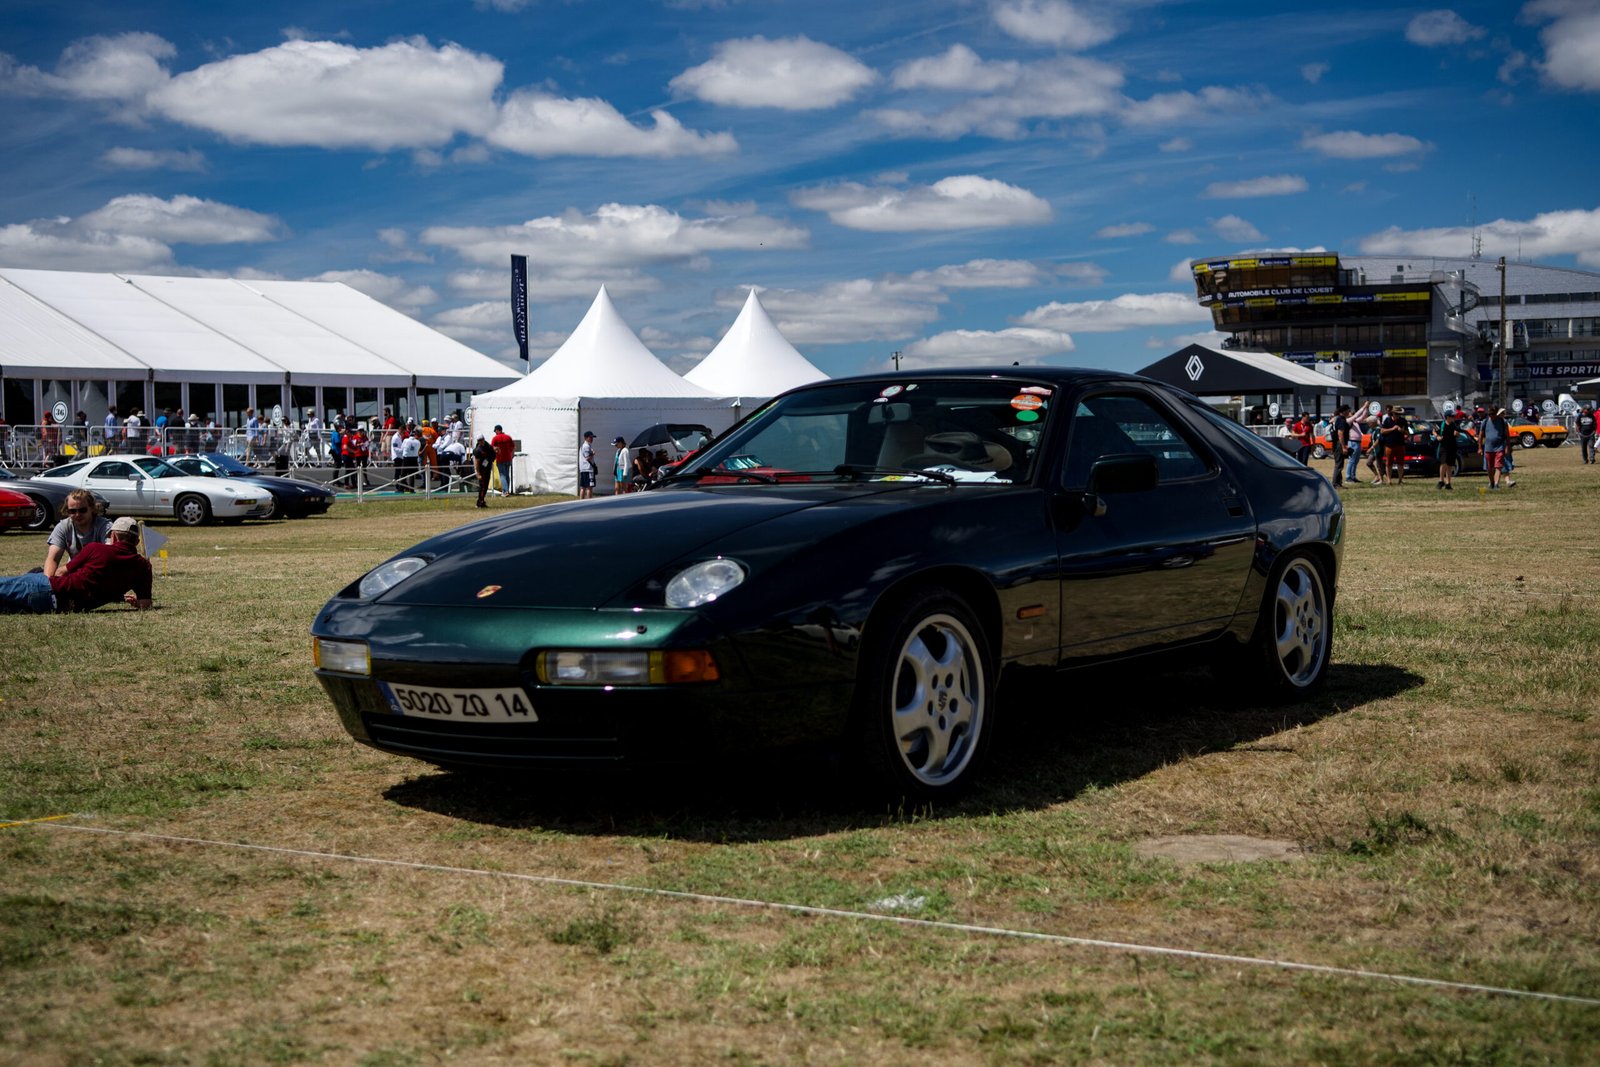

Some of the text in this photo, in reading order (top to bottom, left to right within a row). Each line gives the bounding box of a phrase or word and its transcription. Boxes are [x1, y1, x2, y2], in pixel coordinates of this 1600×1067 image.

[1228, 289, 1270, 298] AUTOMOBILE
[1531, 367, 1553, 375] ULE
[55, 408, 65, 417] 36
[395, 688, 452, 715] 5020
[454, 694, 490, 717] ZQ
[495, 693, 528, 717] 14
